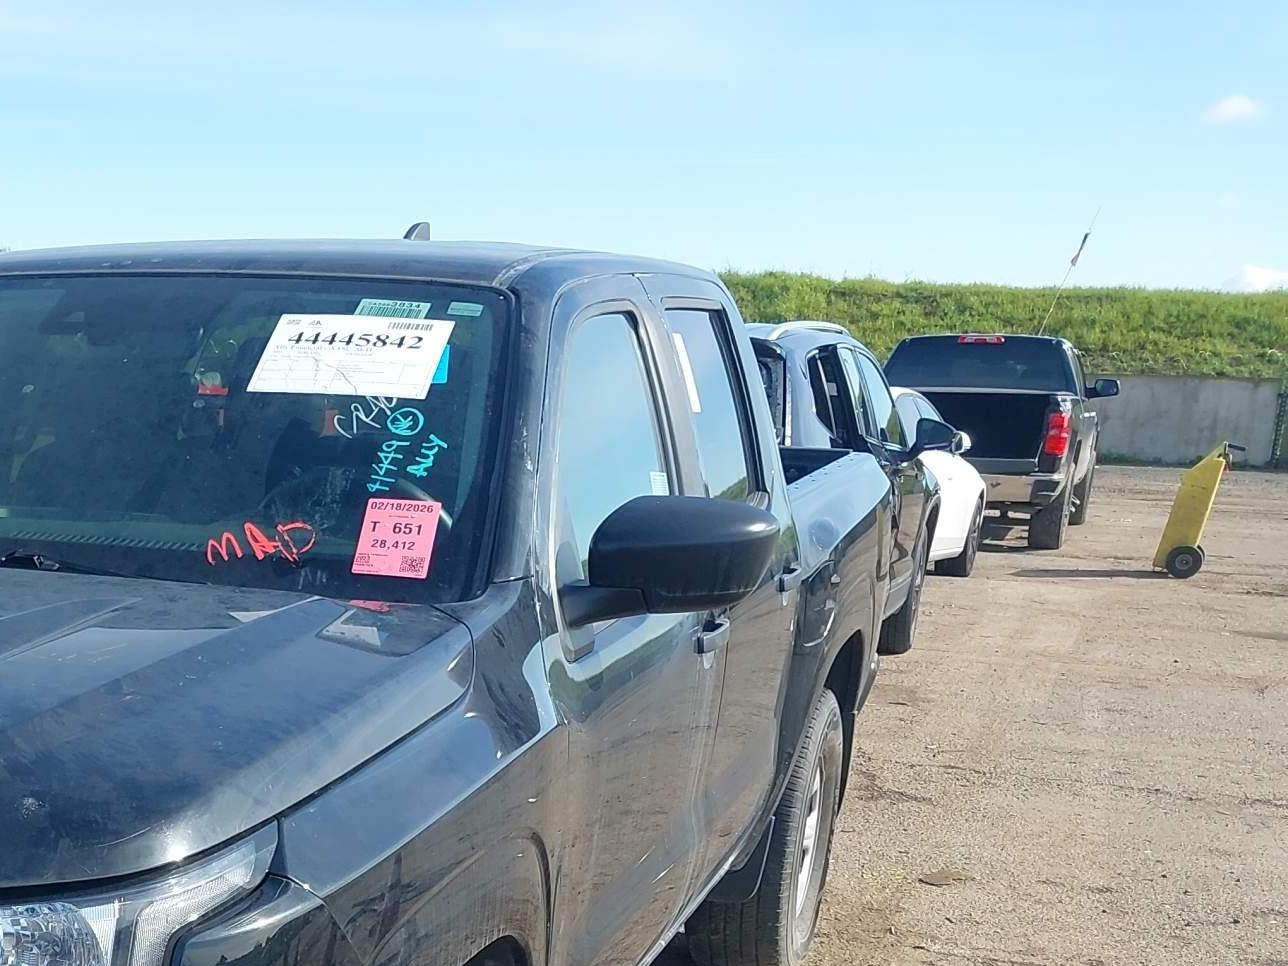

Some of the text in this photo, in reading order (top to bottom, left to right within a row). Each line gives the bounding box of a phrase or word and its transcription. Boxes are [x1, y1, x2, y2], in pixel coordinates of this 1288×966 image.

[288, 331, 424, 350] 44445842
[370, 501, 434, 514] 02/18/2026
[370, 520, 423, 536] T 651
[207, 521, 316, 567] MAD
[370, 538, 416, 551] 28,412
